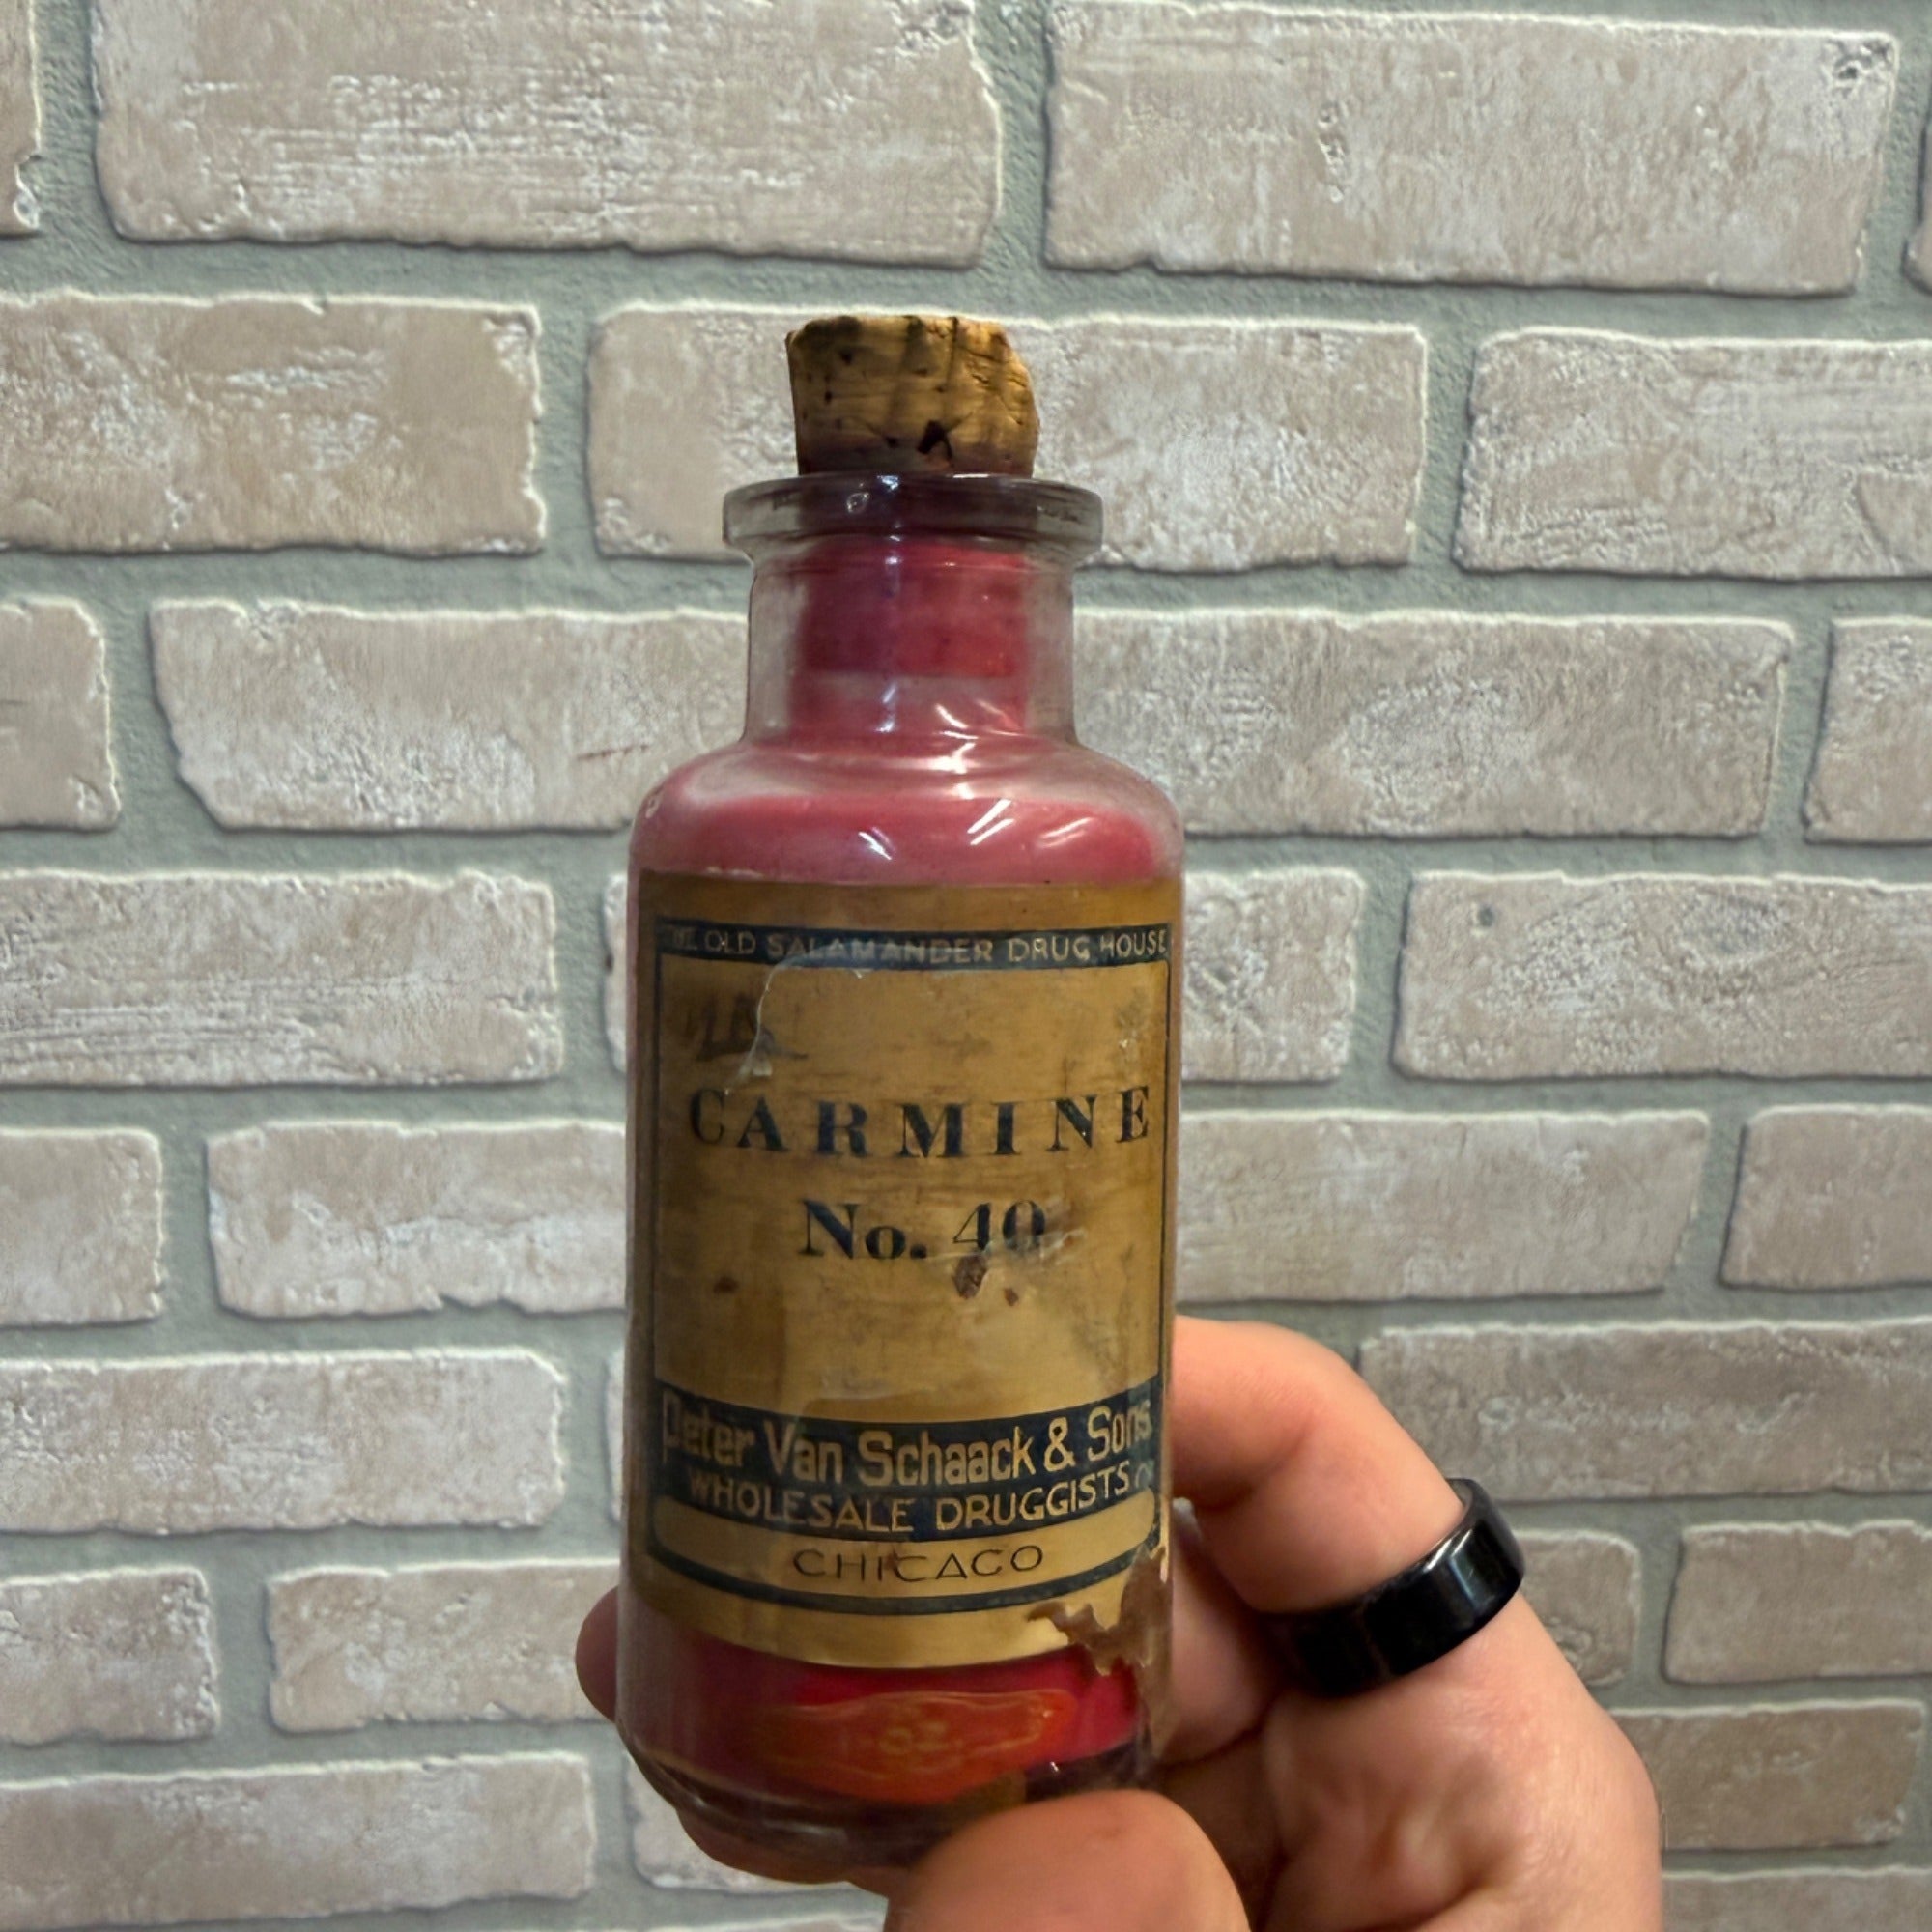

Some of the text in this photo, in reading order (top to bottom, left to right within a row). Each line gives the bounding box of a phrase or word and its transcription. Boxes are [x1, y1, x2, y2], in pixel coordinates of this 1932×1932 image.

[704, 929, 756, 954] OLD
[765, 932, 993, 964] SALAMANDER
[1008, 934, 1091, 962] DRUG
[1099, 928, 1167, 958] HOUSE
[690, 1085, 1149, 1158] CARMINE
[797, 1198, 1046, 1260] No. 40
[662, 1389, 756, 1468] Peter
[763, 1418, 843, 1484] Van
[857, 1425, 1037, 1488] Schaack
[1043, 1416, 1077, 1473] &
[1087, 1399, 1152, 1463] Sons
[689, 1465, 915, 1533] WHOLESALE
[935, 1460, 1130, 1532] DRUGGISTS
[792, 1544, 1043, 1583] CHICAGO
